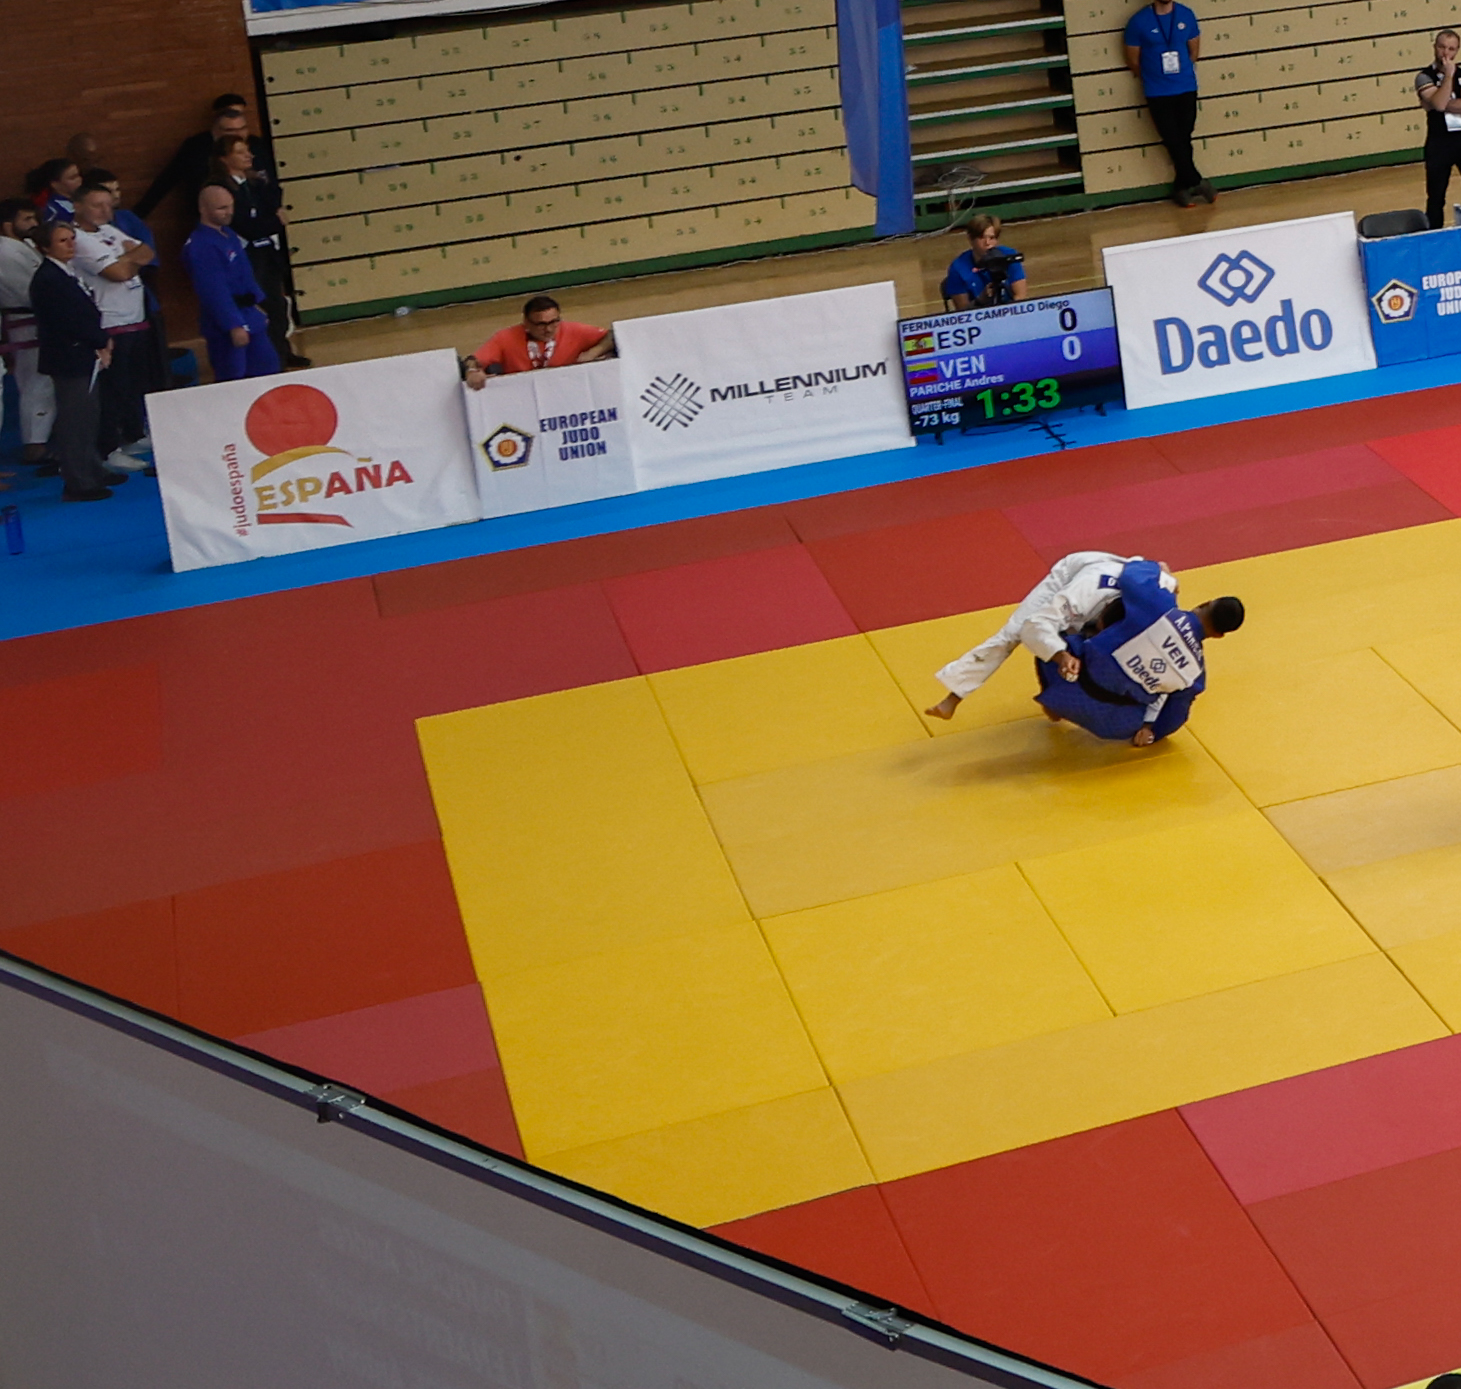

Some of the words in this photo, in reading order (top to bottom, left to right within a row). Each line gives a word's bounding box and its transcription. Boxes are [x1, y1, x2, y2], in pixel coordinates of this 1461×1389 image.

[902, 313, 972, 333] FERNANDEZ
[975, 304, 1034, 322] CAMPILLO
[1038, 300, 1070, 312] Diego
[937, 326, 981, 350] ESP
[1059, 308, 1077, 331] 0
[1153, 297, 1334, 376] Daedo
[939, 354, 986, 378] VEN
[1062, 336, 1081, 360] 0
[709, 360, 888, 405] MILLENNIUM
[765, 384, 839, 406] TEAM
[909, 380, 962, 398] PARICHE
[965, 374, 1004, 388] Andres
[539, 406, 618, 433] EUROPEAN
[914, 414, 939, 428] -73
[942, 411, 961, 425] kg
[976, 378, 1061, 419] 1:33
[558, 439, 608, 461] UNION
[561, 426, 600, 446] JUDO
[256, 456, 414, 512] ESPAÑA
[1161, 636, 1190, 669] VEN
